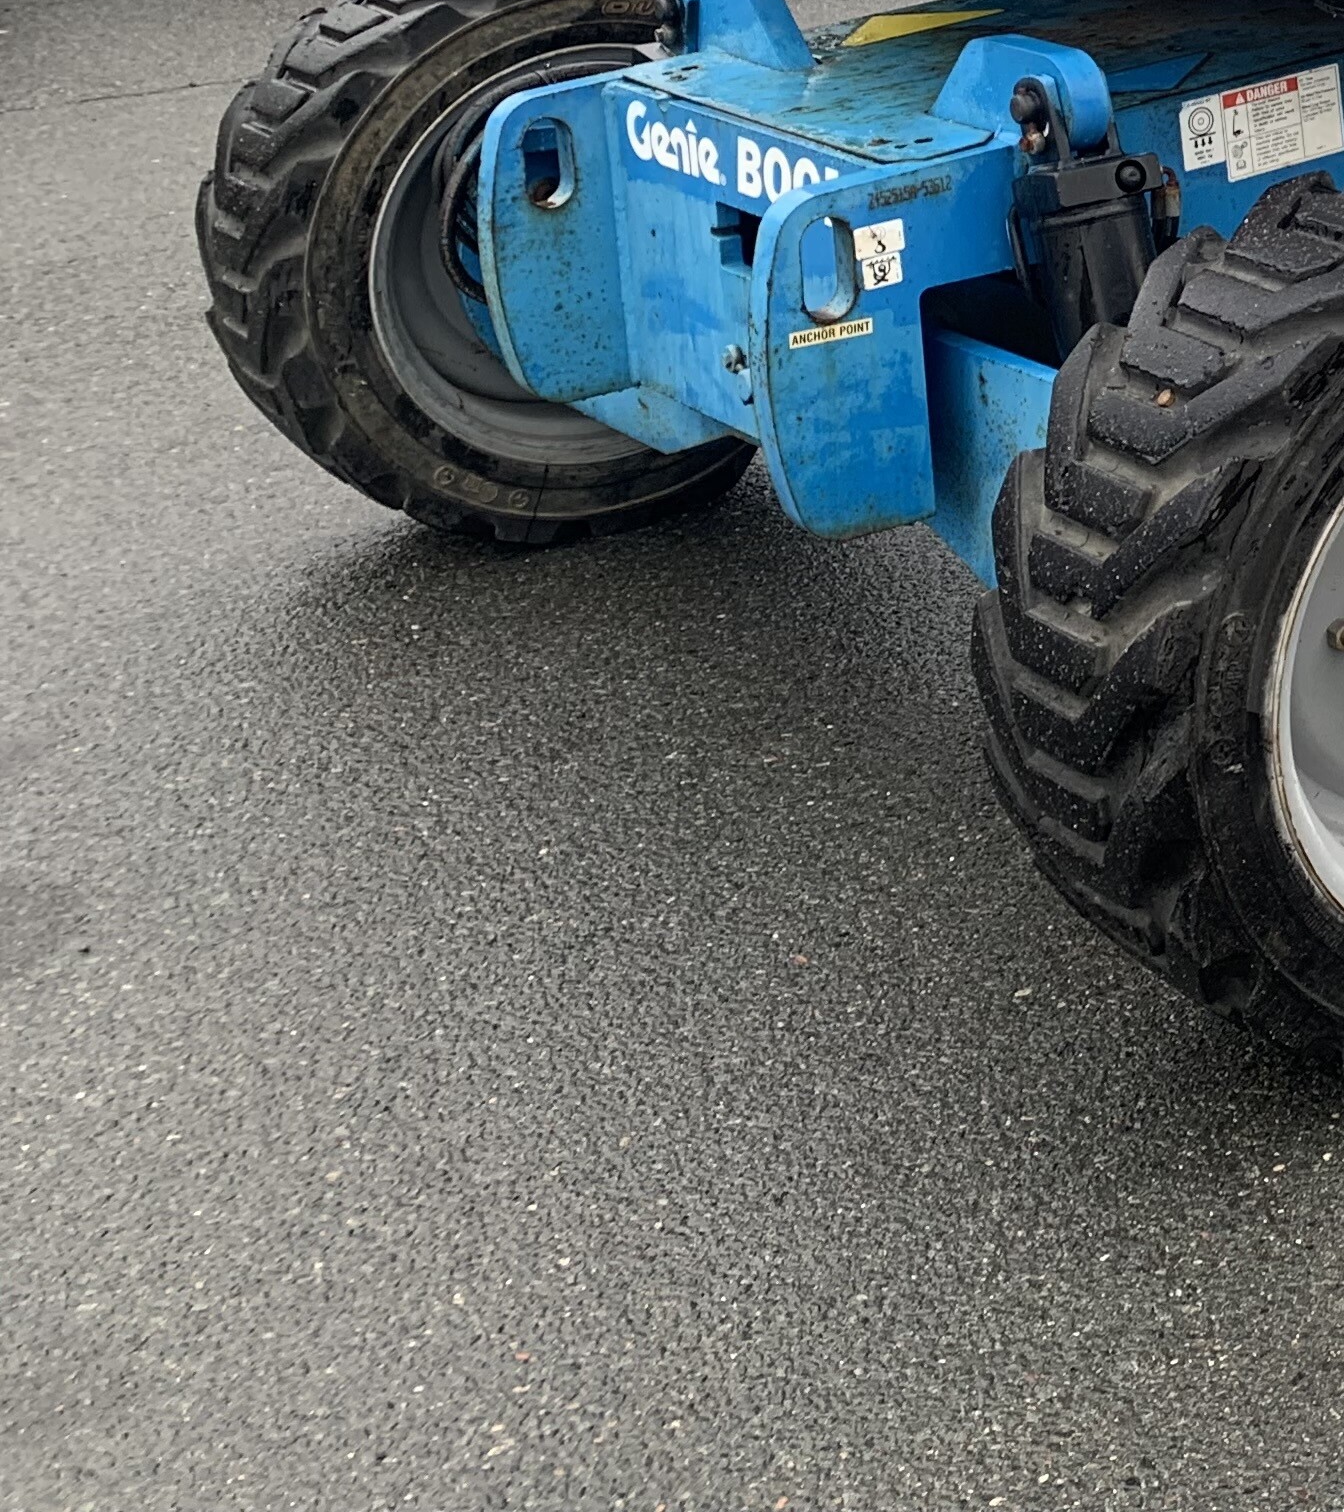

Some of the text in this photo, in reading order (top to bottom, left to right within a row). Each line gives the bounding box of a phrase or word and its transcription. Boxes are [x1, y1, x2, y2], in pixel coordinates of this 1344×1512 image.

[1245, 80, 1289, 102] DANGER
[626, 100, 839, 204] Genie BOO
[792, 321, 870, 346] ANCHOR POINT
